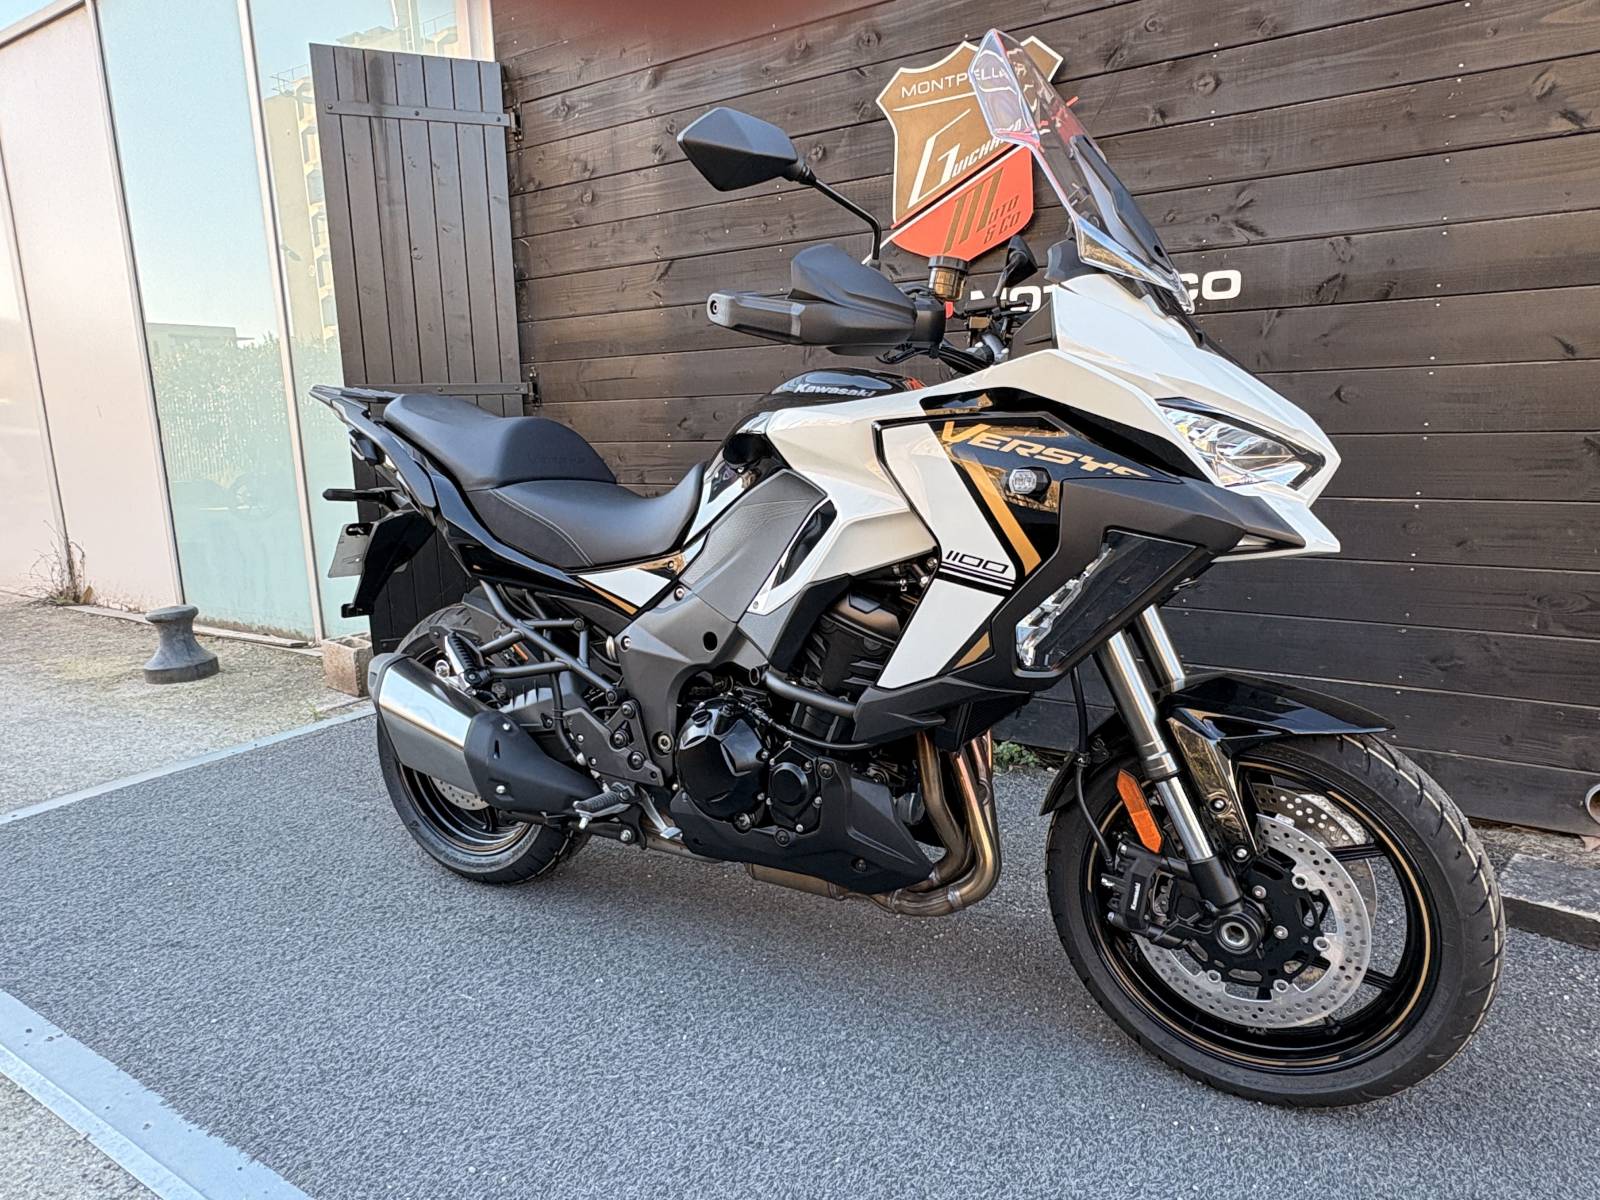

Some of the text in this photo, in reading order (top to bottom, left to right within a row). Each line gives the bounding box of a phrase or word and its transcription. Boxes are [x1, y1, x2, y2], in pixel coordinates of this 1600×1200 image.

[901, 61, 1027, 98] MONTPELL
[907, 108, 1021, 208] GUICHAD
[793, 383, 877, 397] Kawasaki
[945, 550, 1009, 574] 1100
